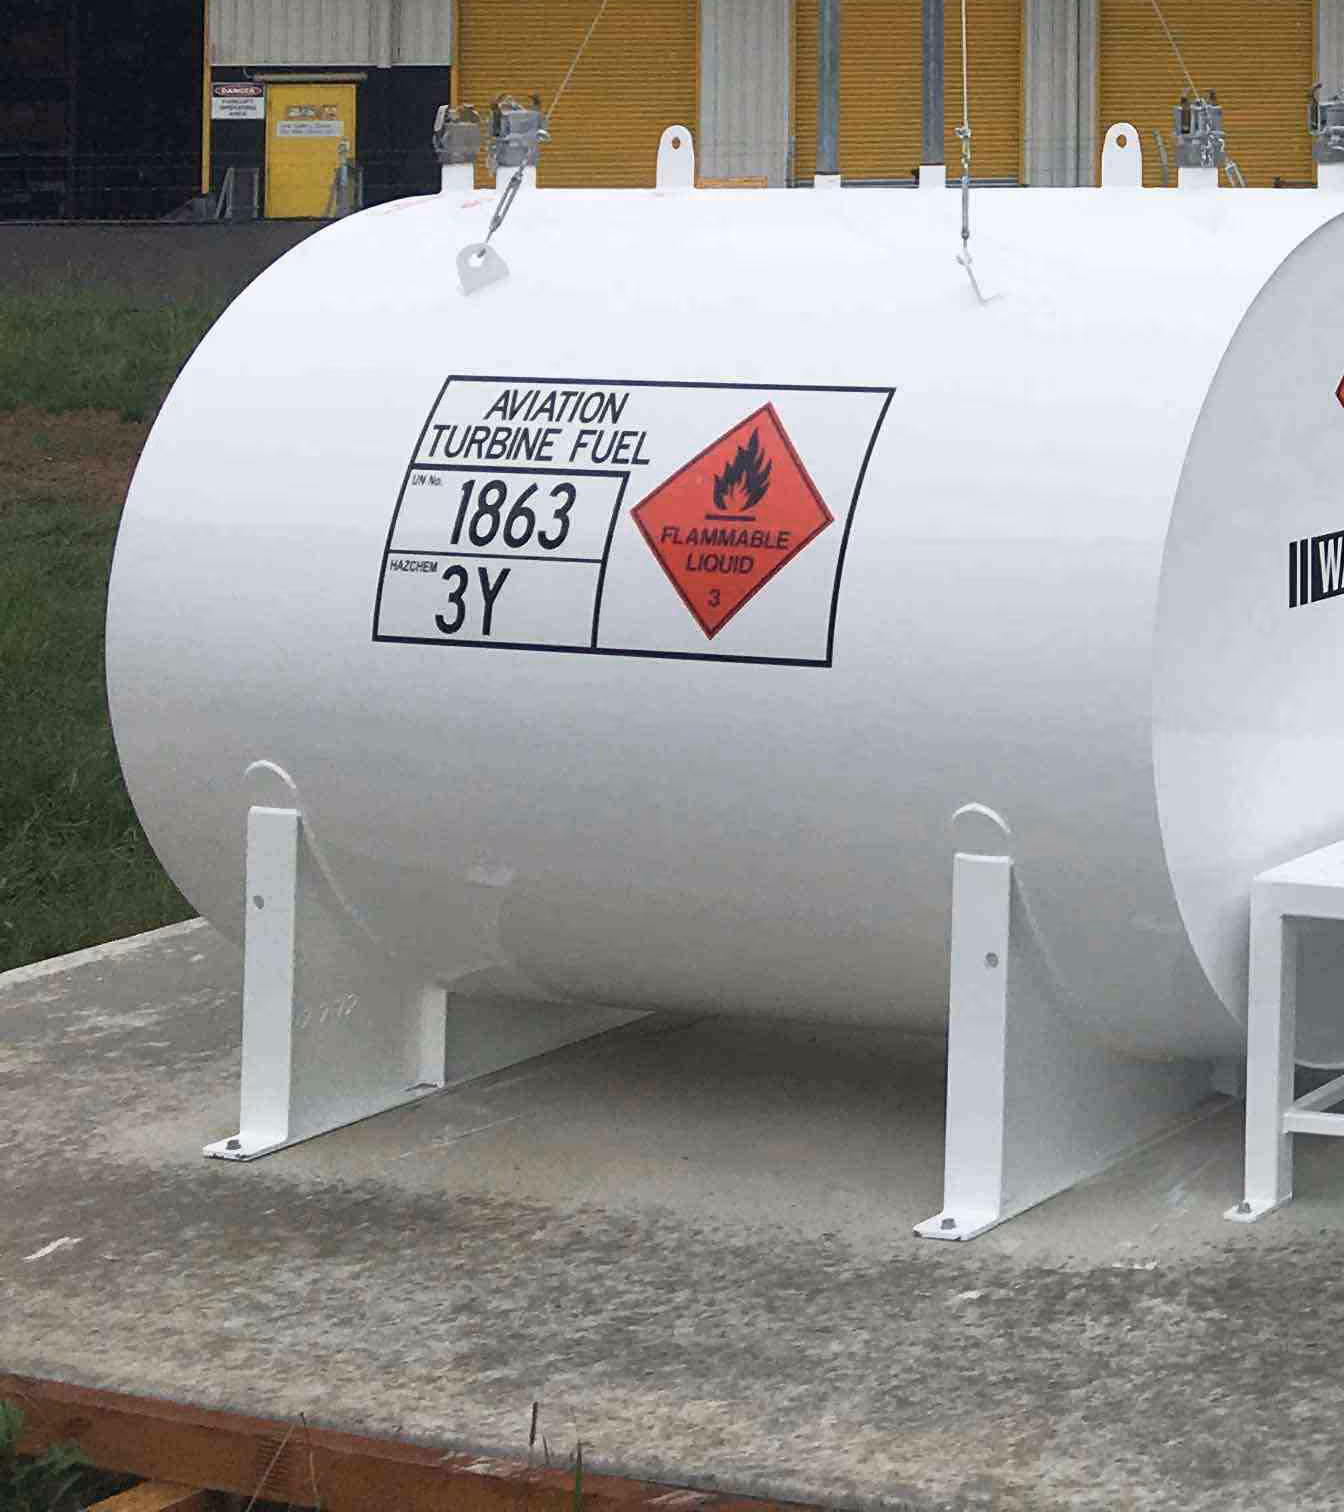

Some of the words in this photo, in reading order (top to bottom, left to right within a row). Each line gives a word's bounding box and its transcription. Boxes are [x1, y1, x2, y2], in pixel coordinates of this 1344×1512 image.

[483, 389, 630, 424] AVIATION
[426, 424, 562, 462] TURBINE
[569, 430, 650, 466] FUEL
[450, 479, 577, 550] 1863
[660, 526, 792, 551] FLAMMABLE
[390, 559, 438, 573] HAZCHEM
[684, 553, 756, 576] LIQUID
[435, 563, 511, 636] 3Y
[706, 588, 721, 608] 3
